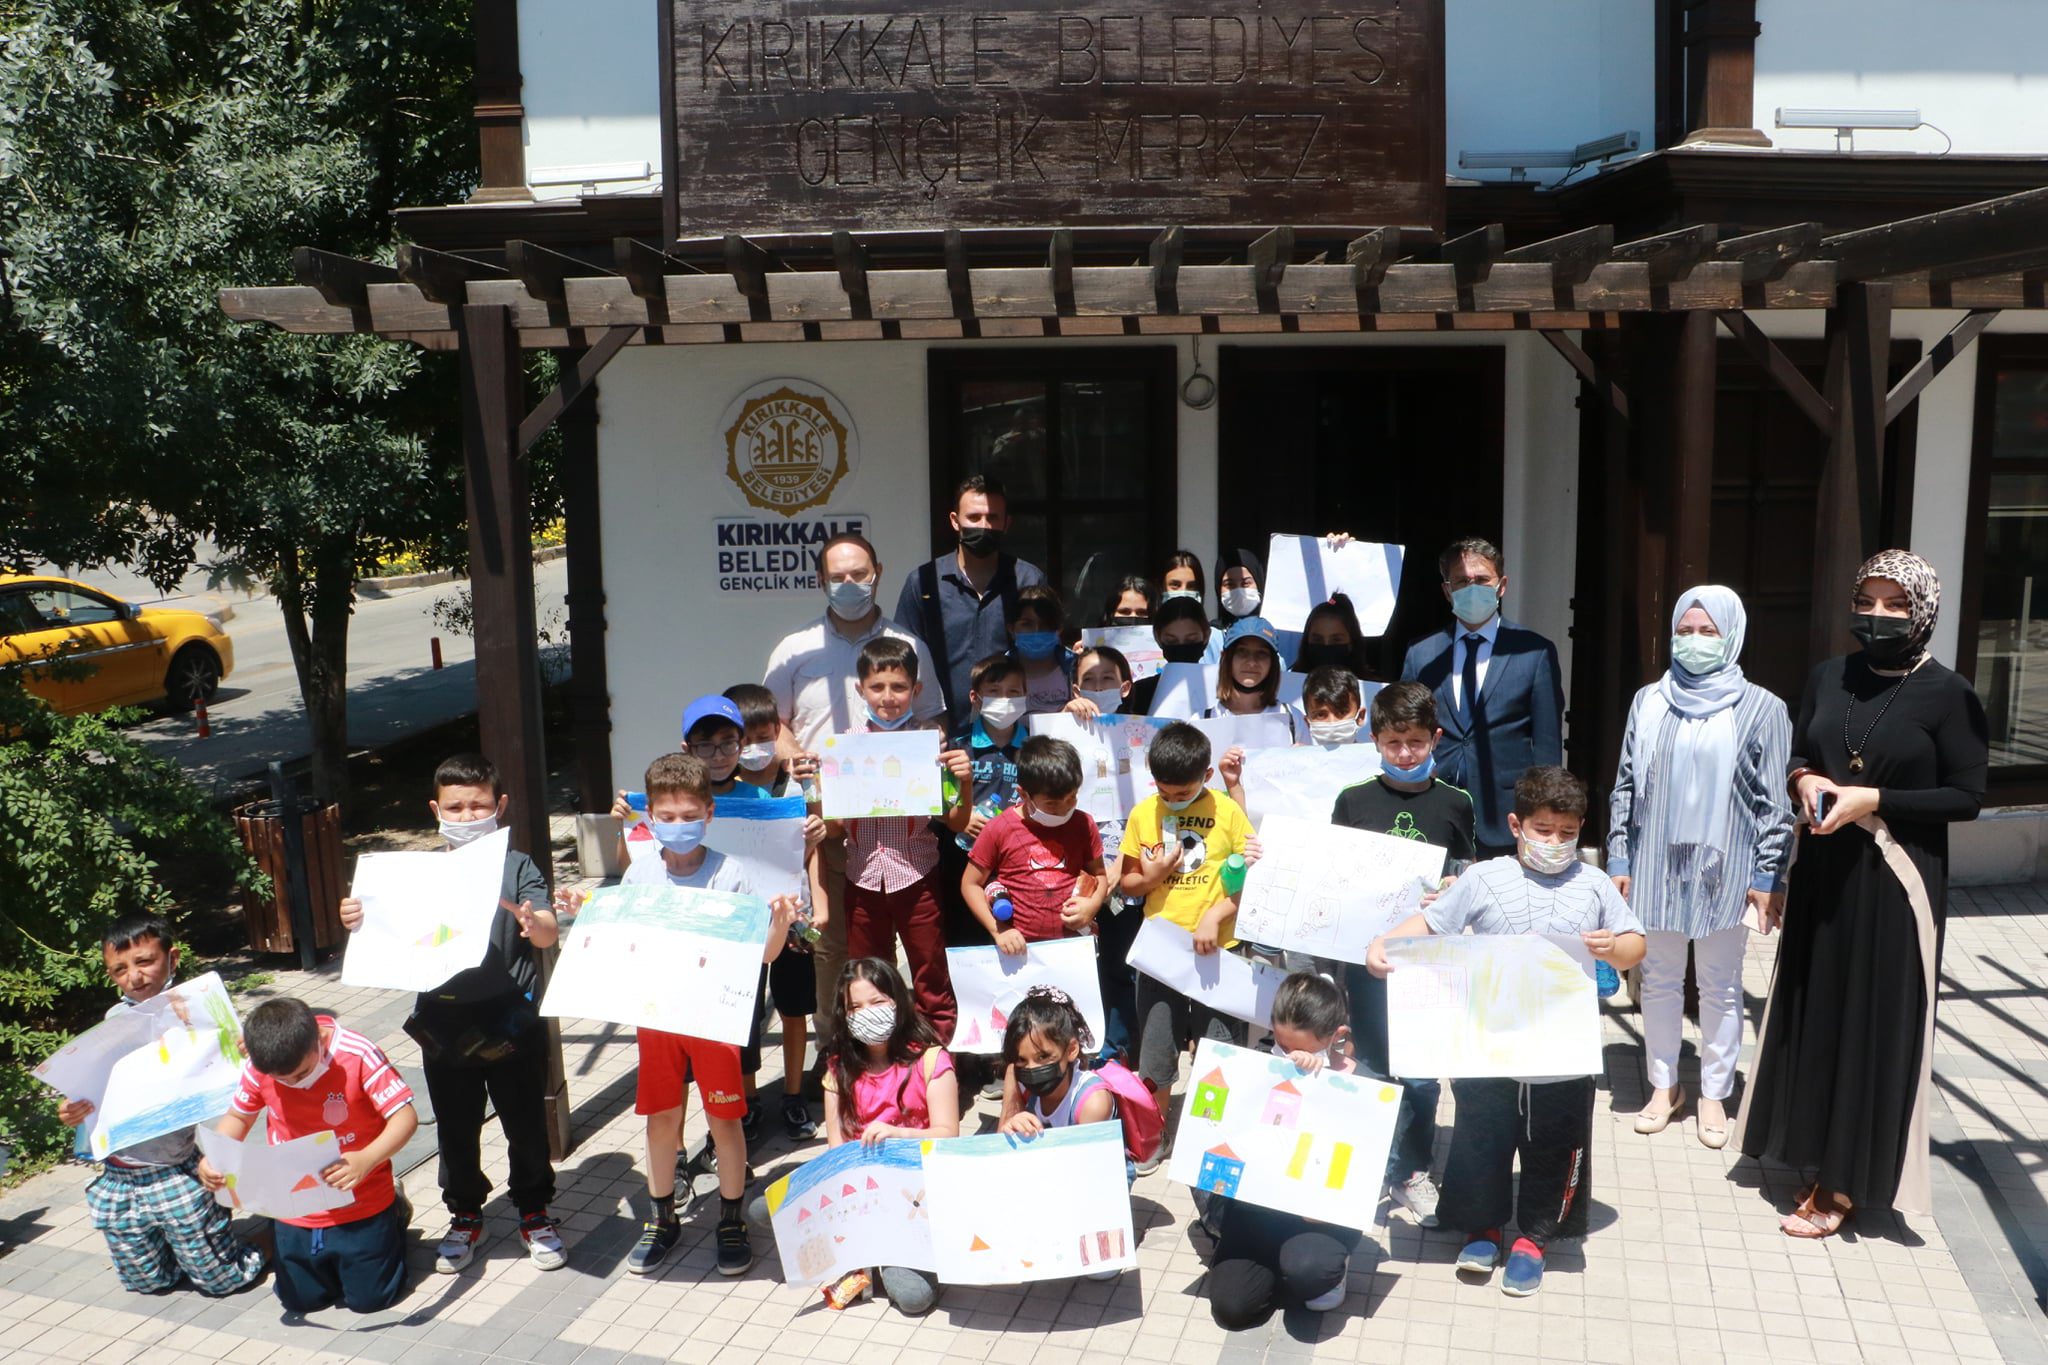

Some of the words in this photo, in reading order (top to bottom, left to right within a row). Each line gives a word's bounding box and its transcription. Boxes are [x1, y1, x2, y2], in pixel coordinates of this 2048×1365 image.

[702, 17, 1010, 92] KIRIKKALE
[797, 98, 1046, 201] GENÇLİK
[741, 401, 832, 437] KIRIKKALE
[742, 467, 832, 503] BELEDİYESİ
[773, 475, 800, 484] 1939
[719, 573, 789, 593] GENÇLİK
[1161, 815, 1216, 829] GEND
